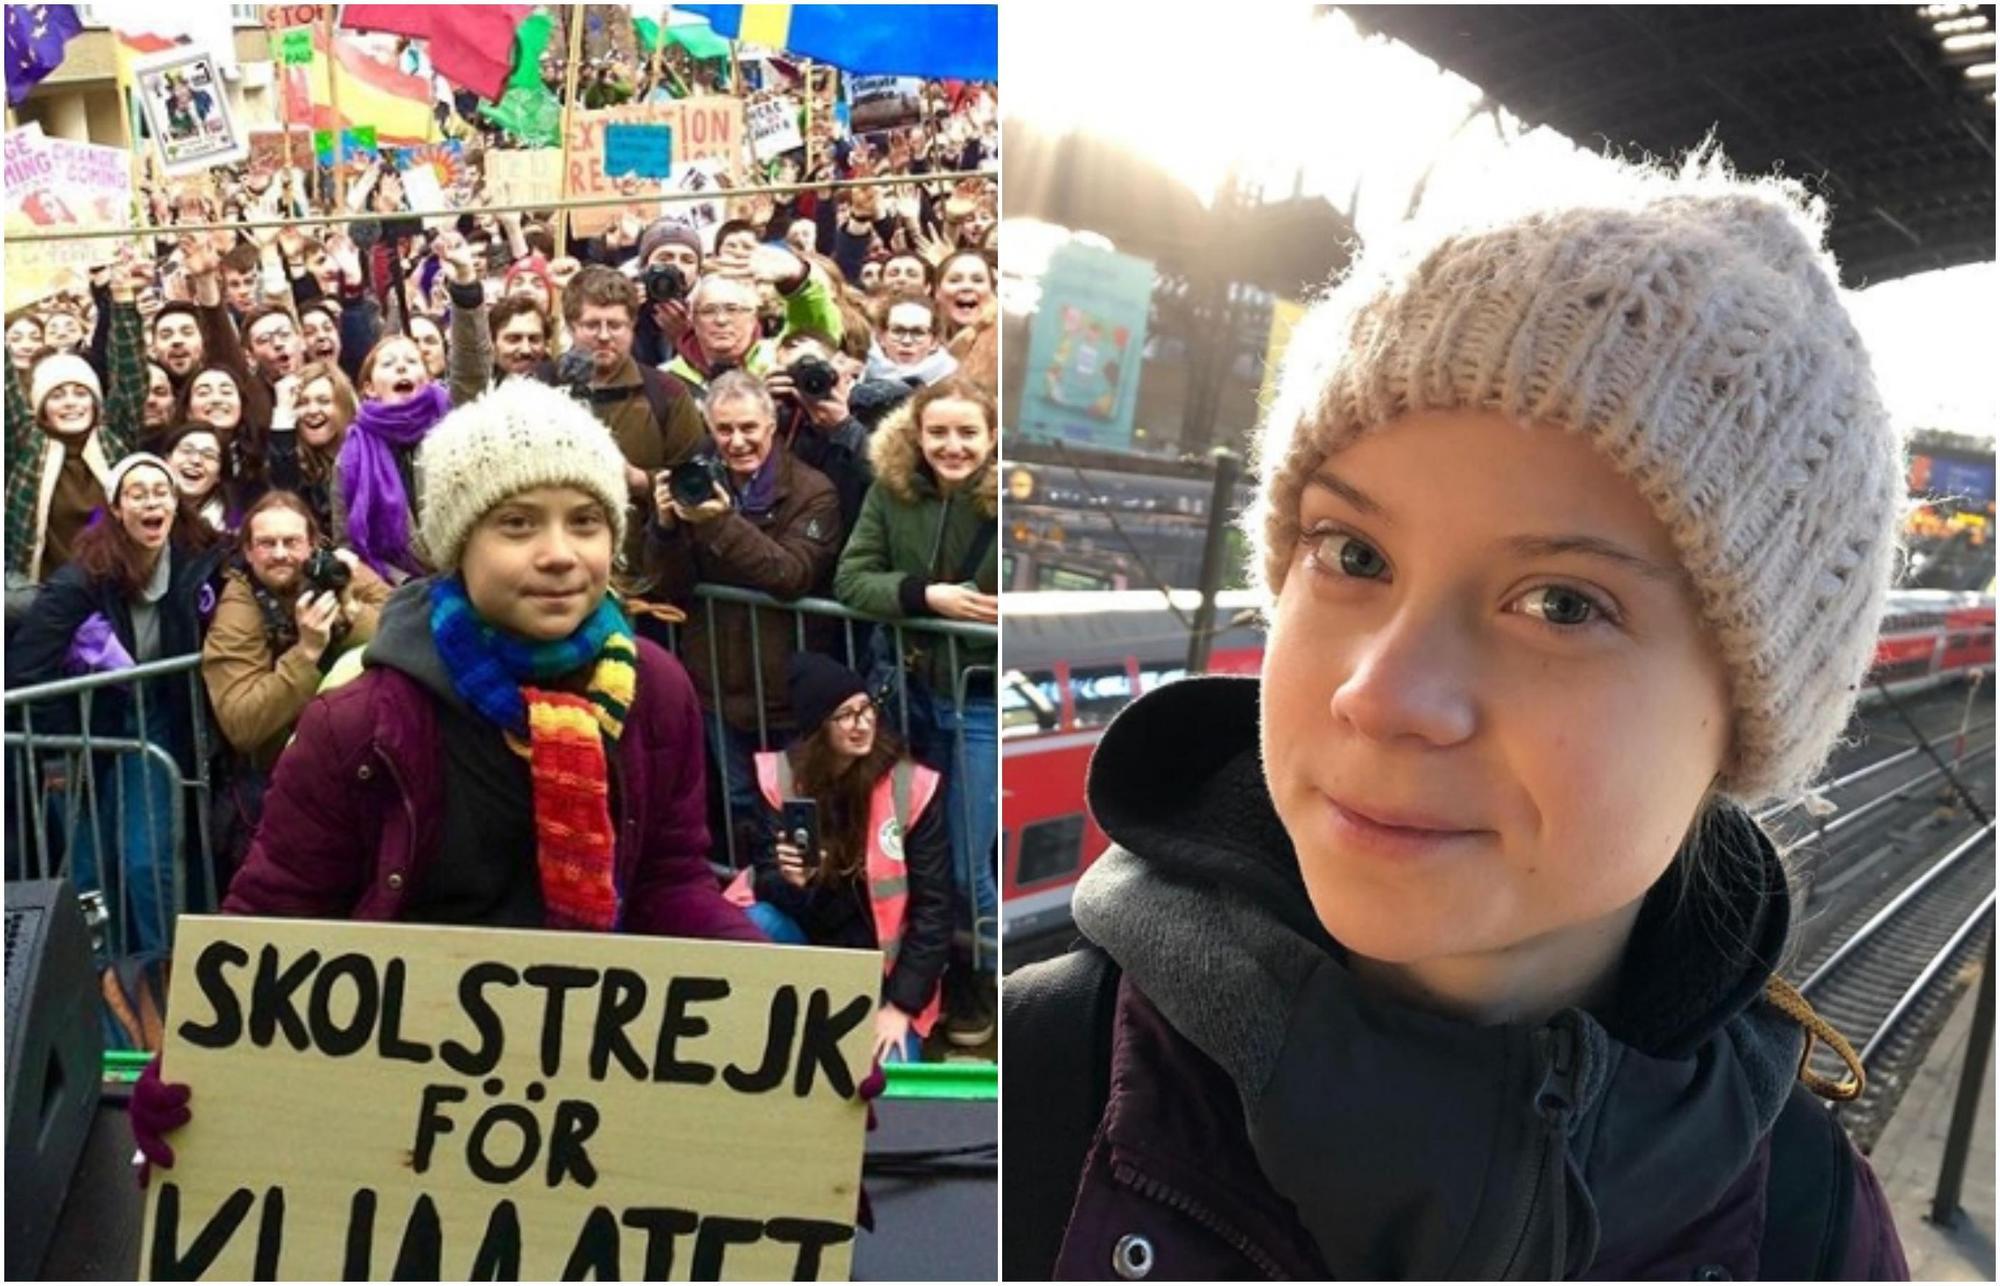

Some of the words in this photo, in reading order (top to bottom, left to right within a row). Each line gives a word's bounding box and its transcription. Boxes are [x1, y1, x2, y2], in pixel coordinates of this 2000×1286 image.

[567, 104, 731, 152] EXION
[178, 940, 873, 1100] SKOLSTREJK
[411, 1078, 600, 1189] FÖR
